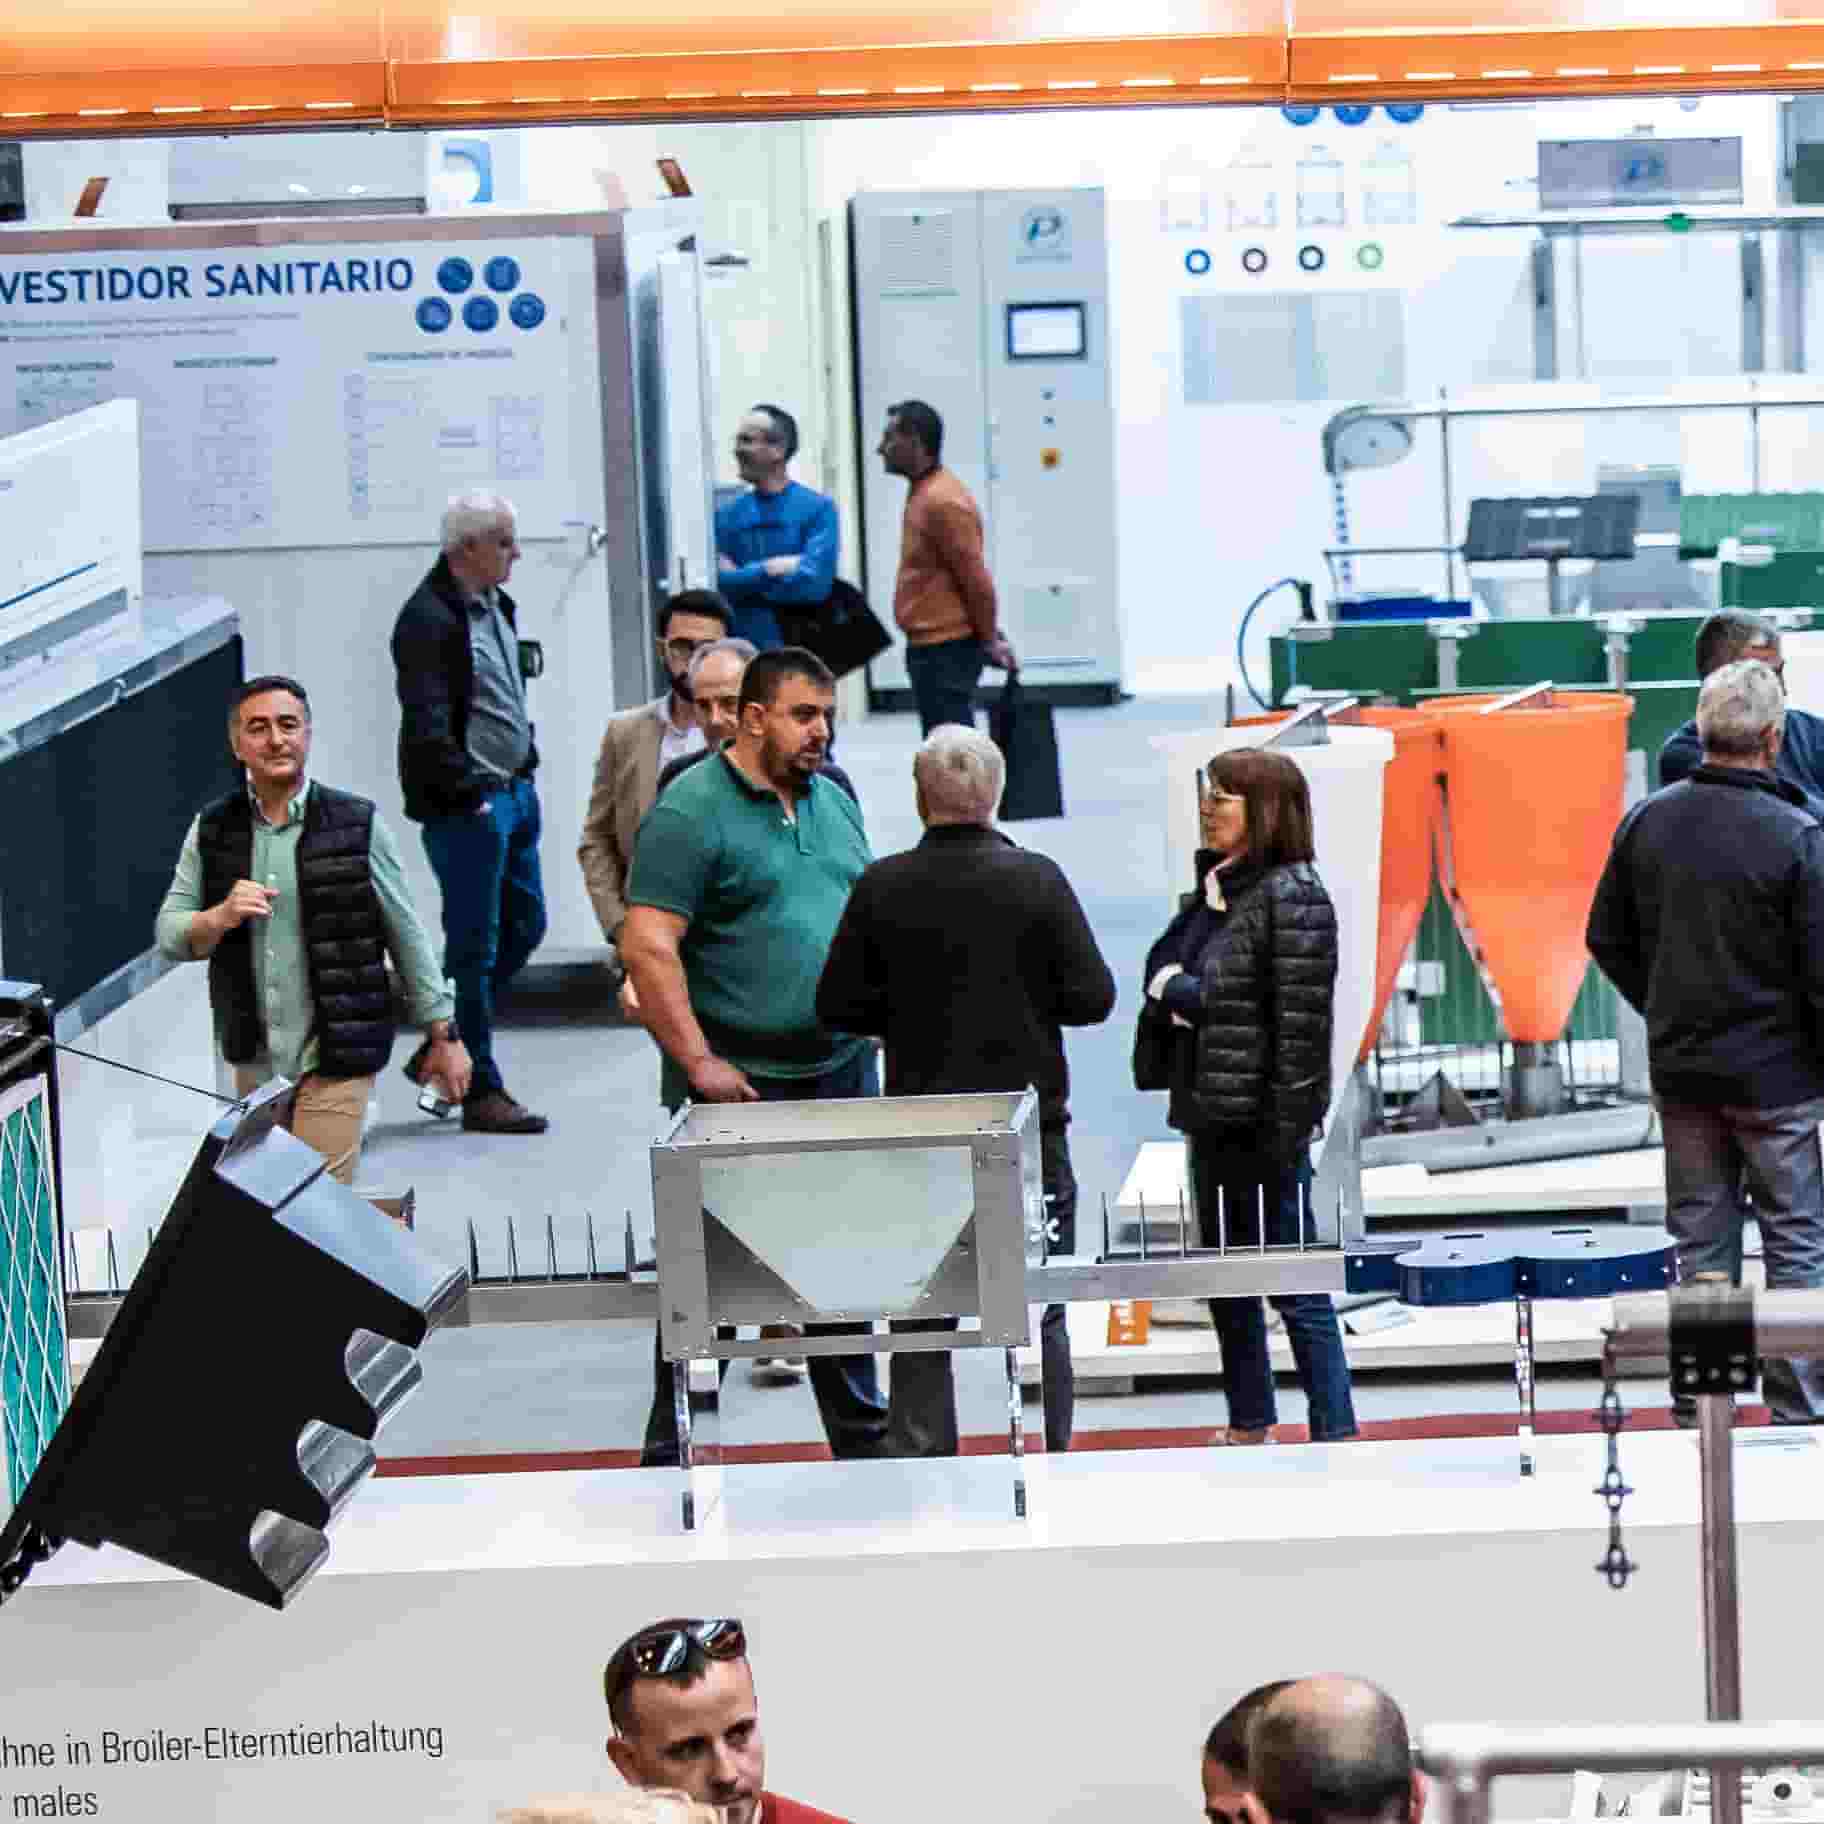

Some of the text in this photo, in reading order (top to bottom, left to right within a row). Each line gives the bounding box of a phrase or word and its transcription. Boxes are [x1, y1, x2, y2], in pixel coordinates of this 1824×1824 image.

[0, 258, 414, 304] VESTIDOR SANITARIO
[0, 1720, 444, 1768] hne in Broiler-Elterntierhaltung
[13, 1785, 99, 1818] males
